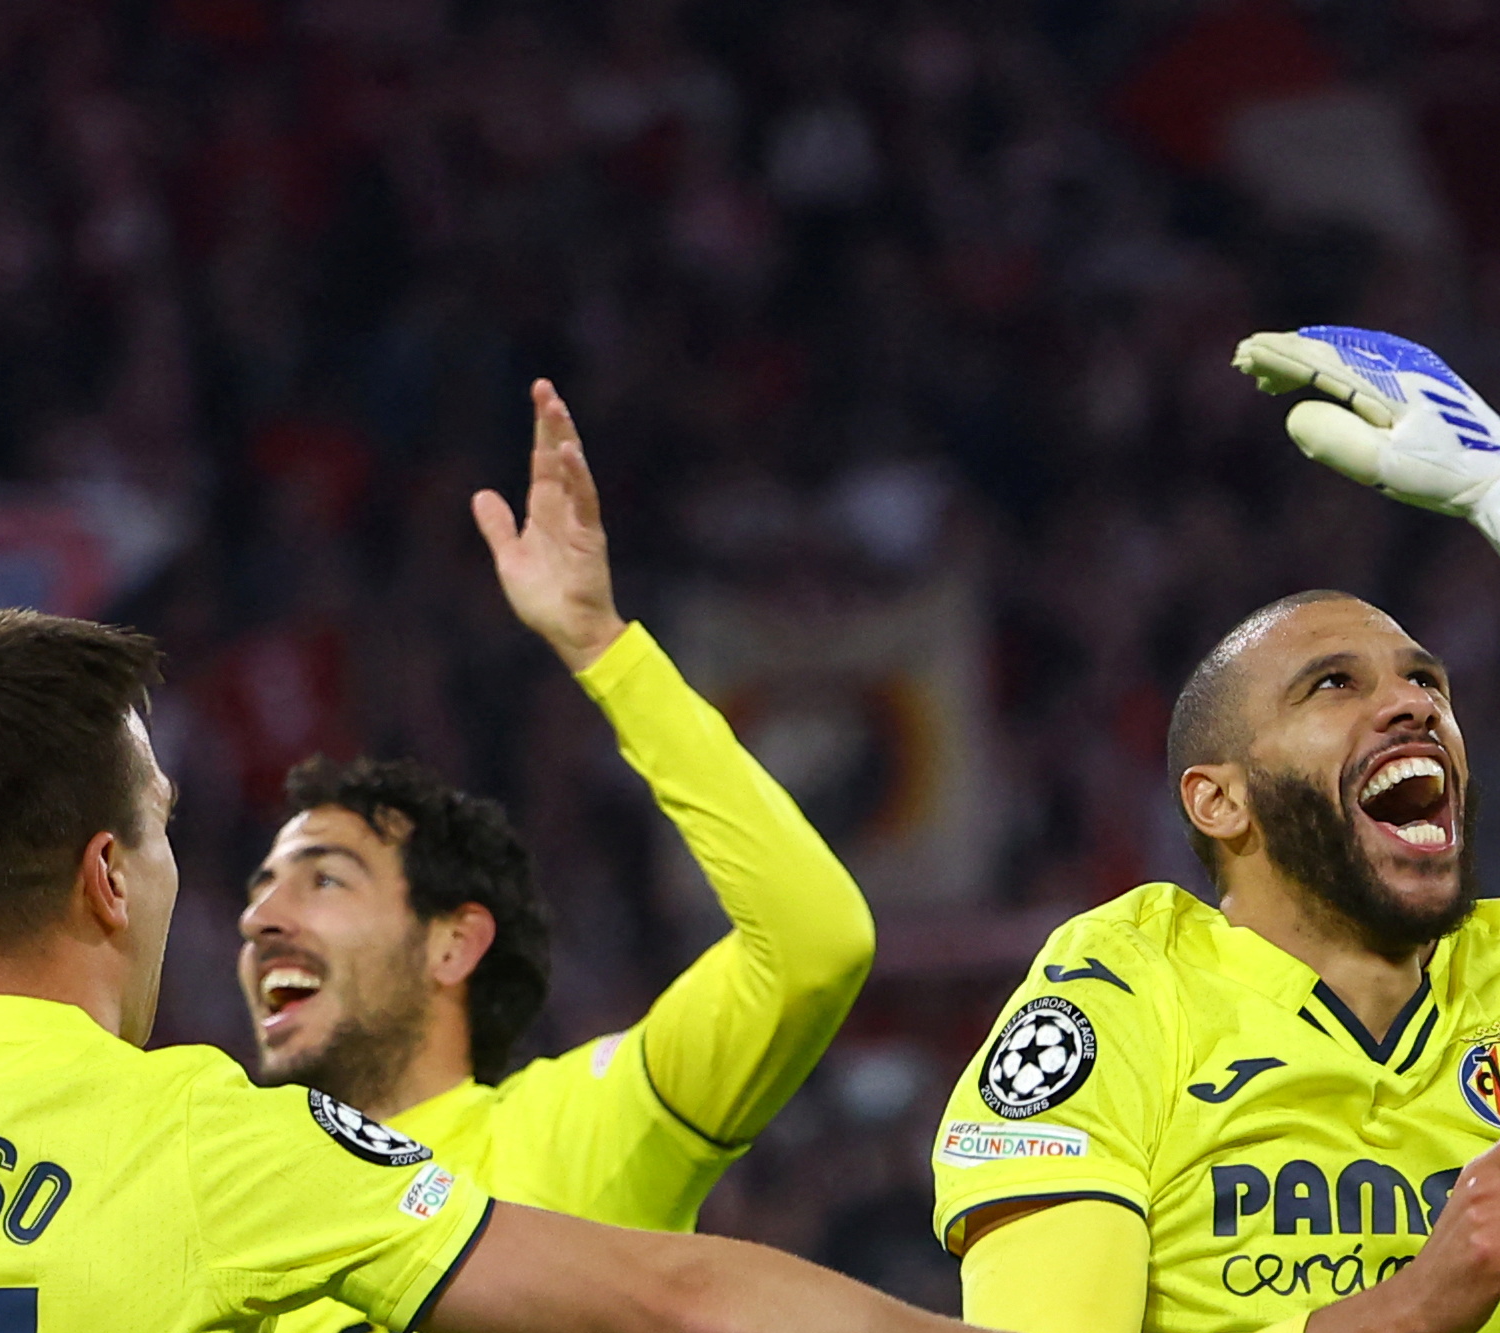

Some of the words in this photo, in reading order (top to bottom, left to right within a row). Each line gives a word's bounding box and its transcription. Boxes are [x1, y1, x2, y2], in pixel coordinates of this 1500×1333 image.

[1001, 1010, 1025, 1038] UEFA
[1027, 998, 1072, 1016] EUROPA
[1071, 1011, 1095, 1060] LEAGUE
[981, 1085, 1000, 1111] 2021
[1001, 1099, 1049, 1118] WINNERS
[950, 1122, 982, 1134] UEFA
[945, 1135, 1082, 1156] FOUNDATION
